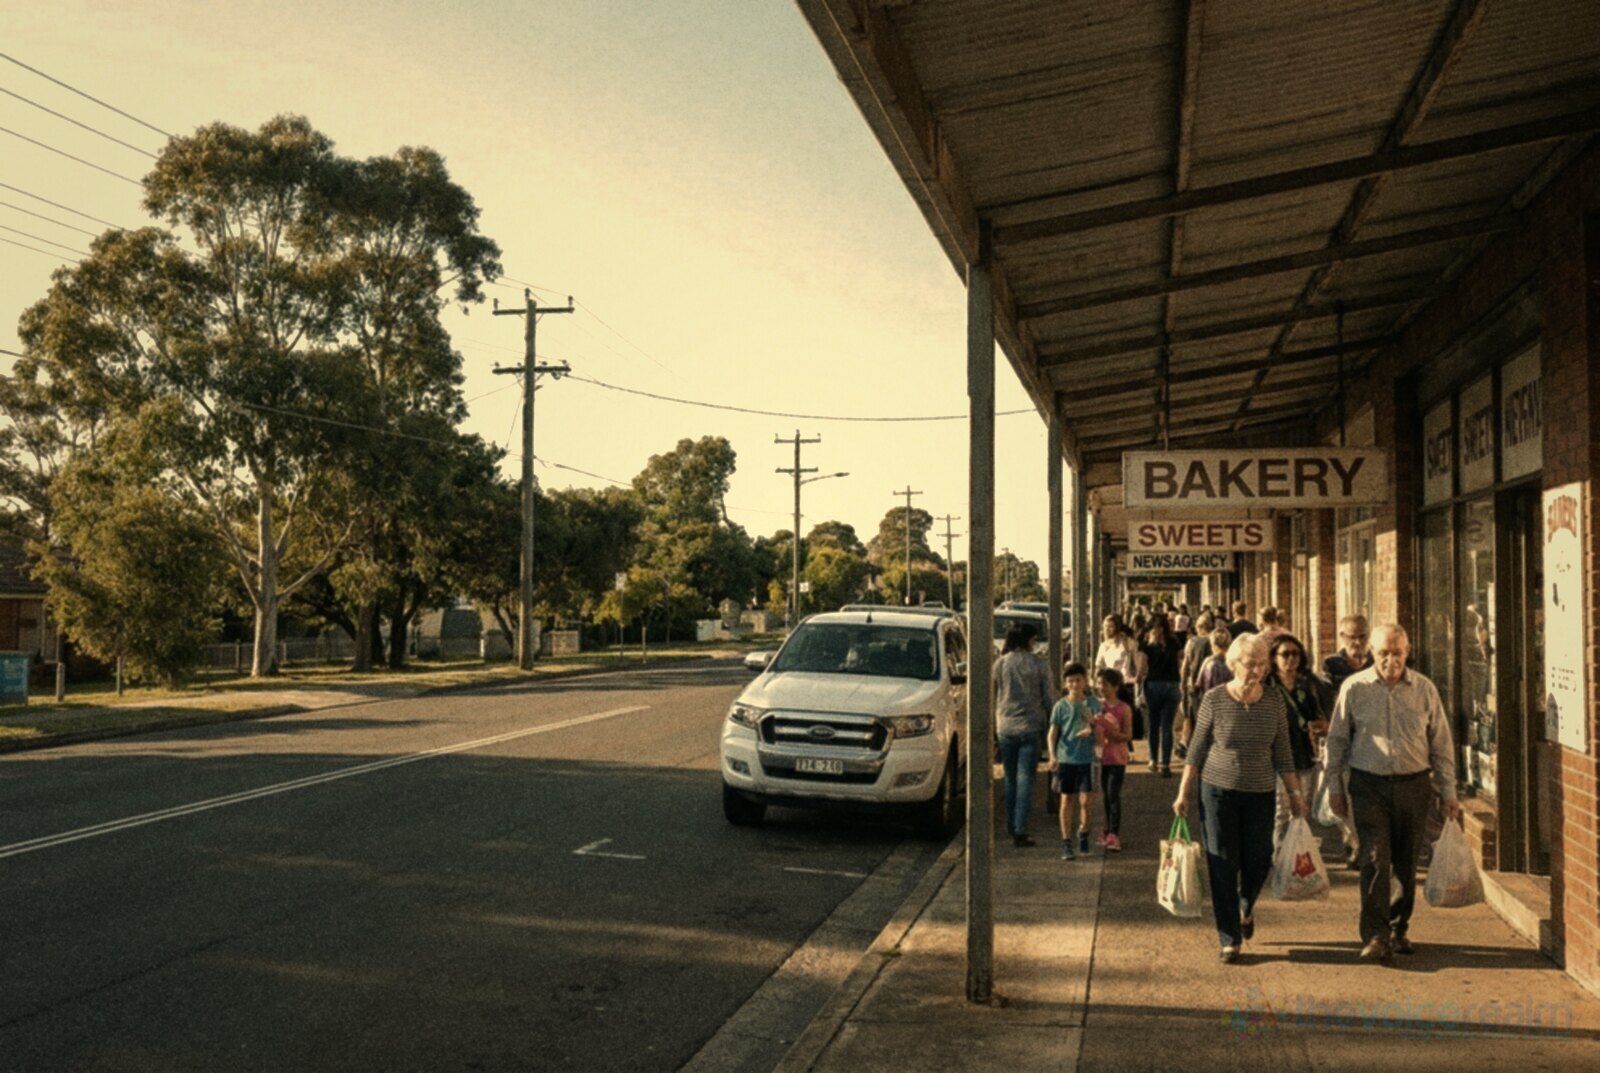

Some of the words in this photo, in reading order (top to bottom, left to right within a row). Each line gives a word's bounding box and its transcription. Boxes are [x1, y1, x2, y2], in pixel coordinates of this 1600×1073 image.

[1144, 457, 1365, 499] BAKERY
[1138, 523, 1264, 548] SWEETS
[1133, 554, 1228, 569] NEWSAGENCY
